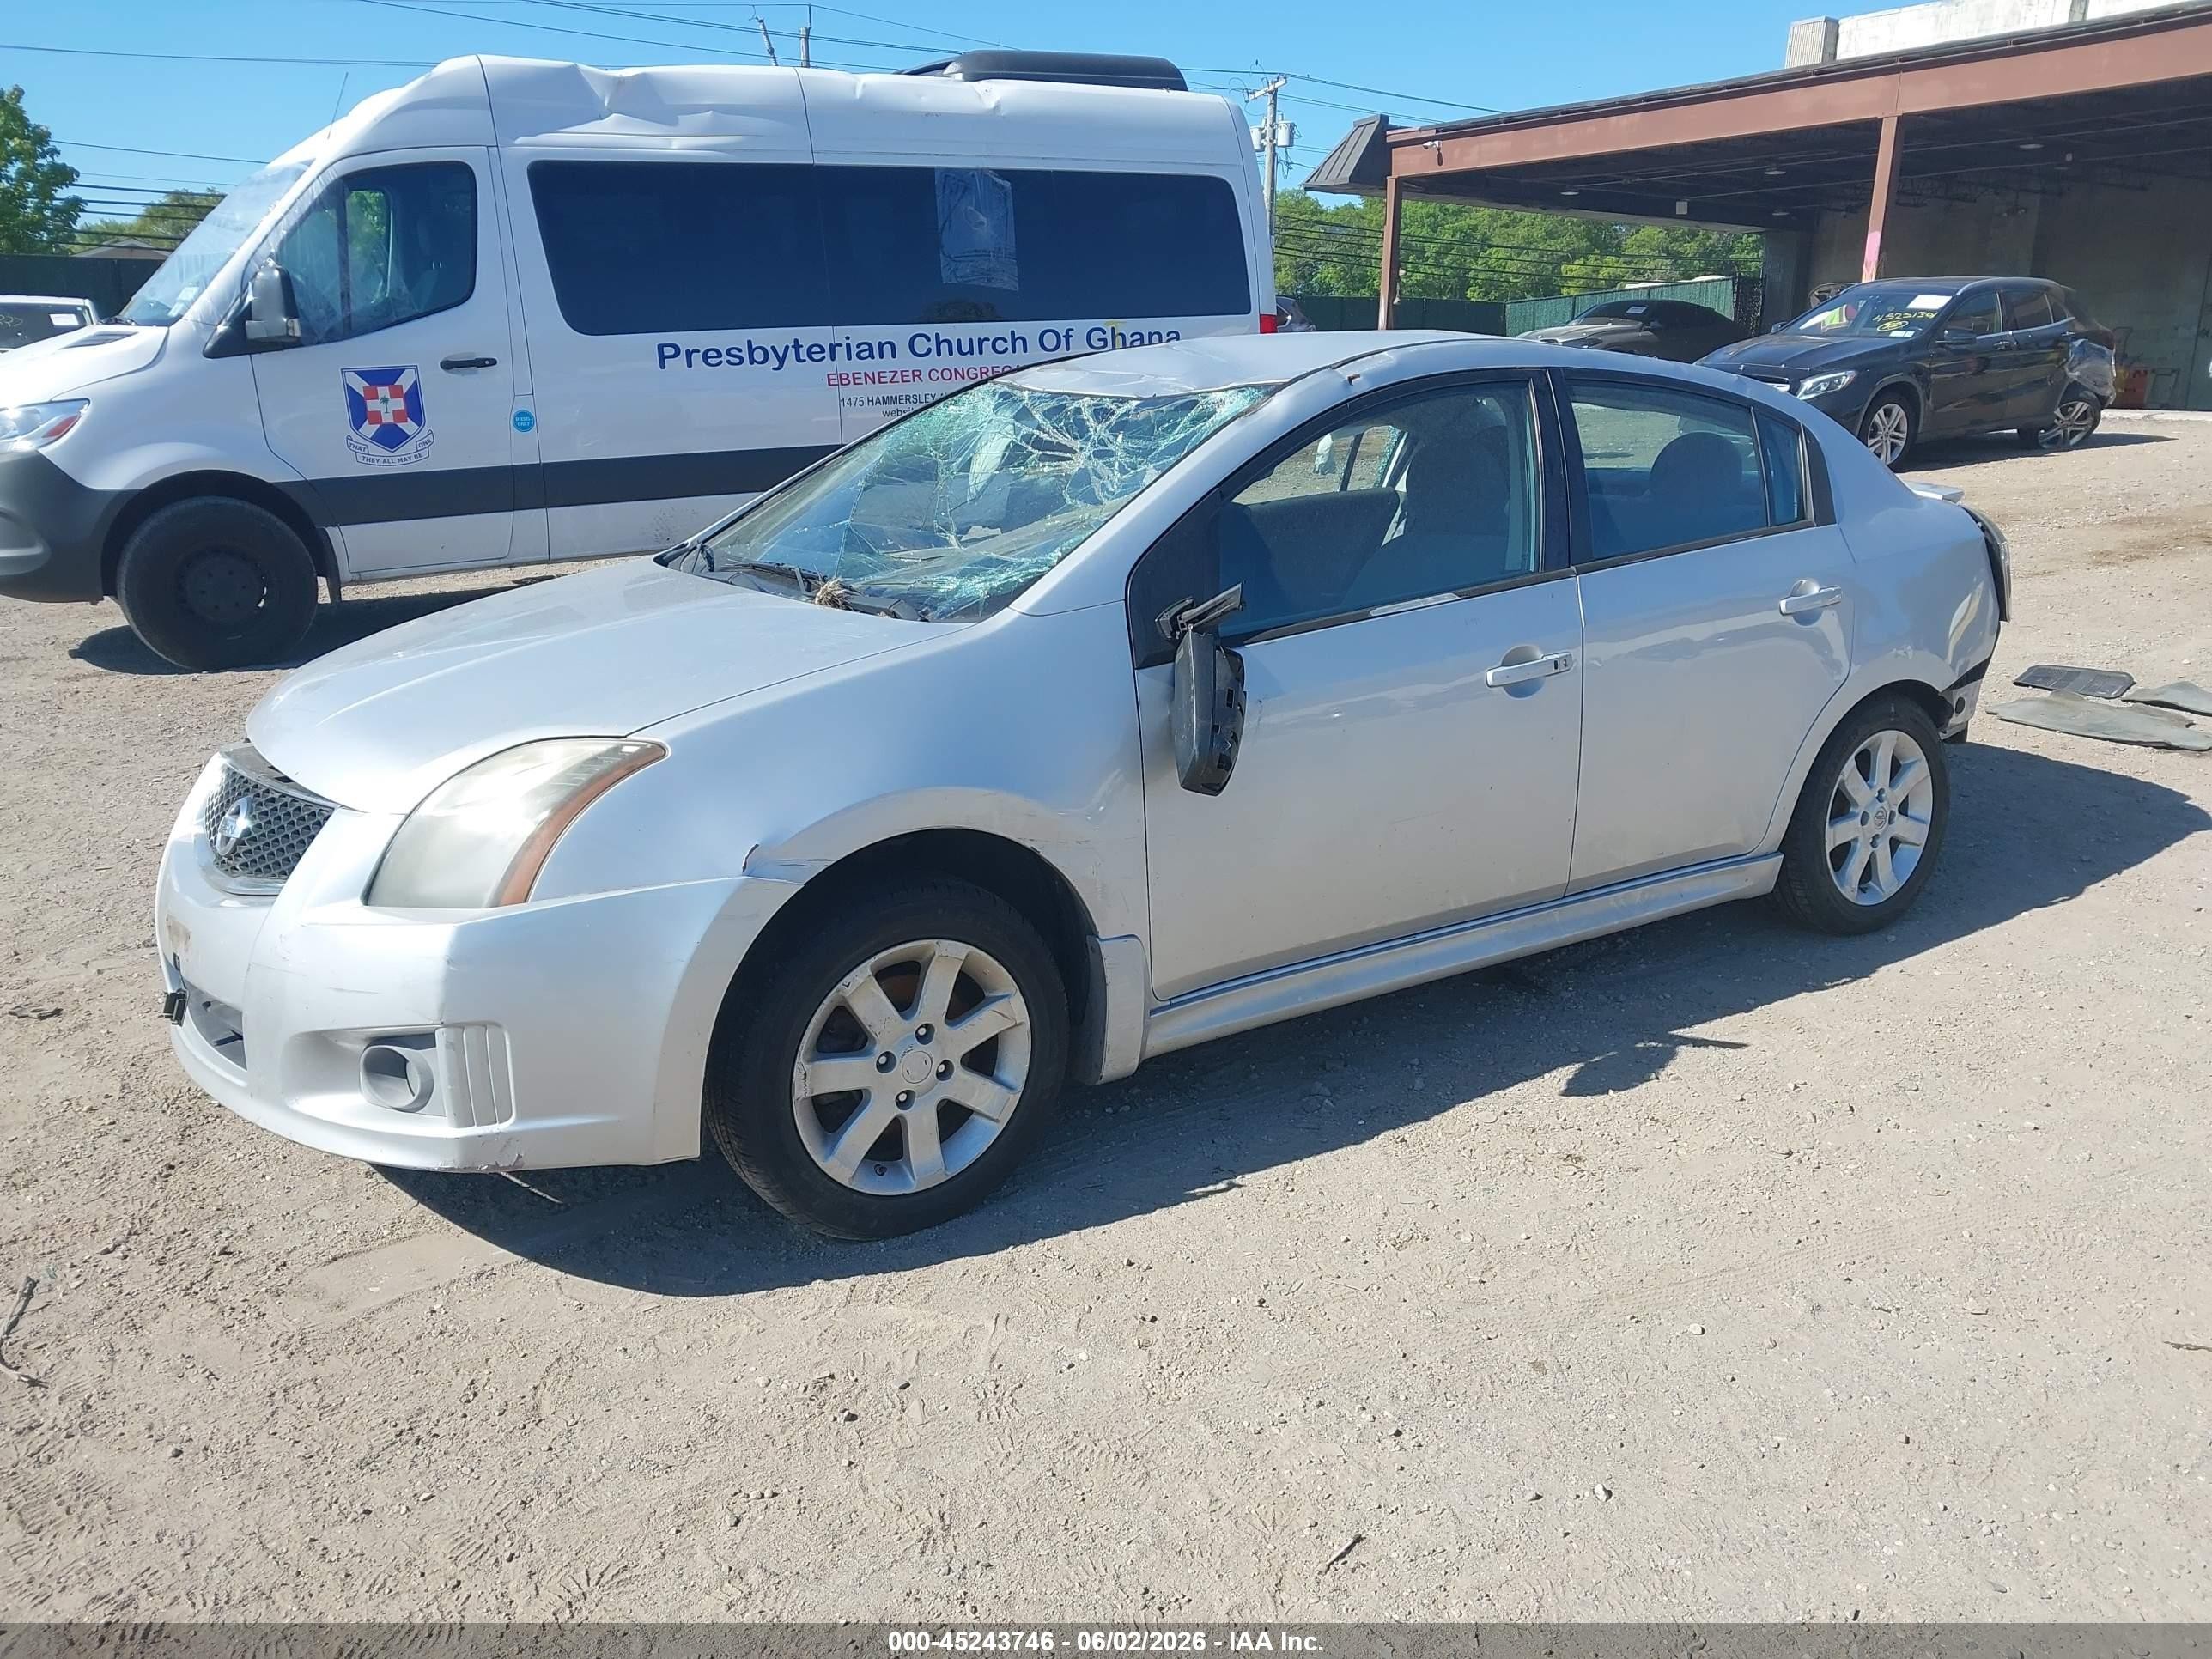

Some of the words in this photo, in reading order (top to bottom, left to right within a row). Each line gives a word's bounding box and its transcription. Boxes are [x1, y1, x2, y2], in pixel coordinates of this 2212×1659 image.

[657, 335, 897, 371] Presbyterian
[908, 329, 1028, 357] Church
[1038, 327, 1074, 352] Of
[1085, 325, 1181, 350] Ghana
[826, 368, 923, 386] EBENEZER
[840, 396, 865, 408] 1475
[866, 392, 937, 407] HAMMERSLEY
[348, 442, 367, 453] THAT
[417, 439, 432, 448] ONE
[362, 455, 381, 464] THEY
[398, 454, 412, 464] MAY
[415, 452, 424, 460] BE
